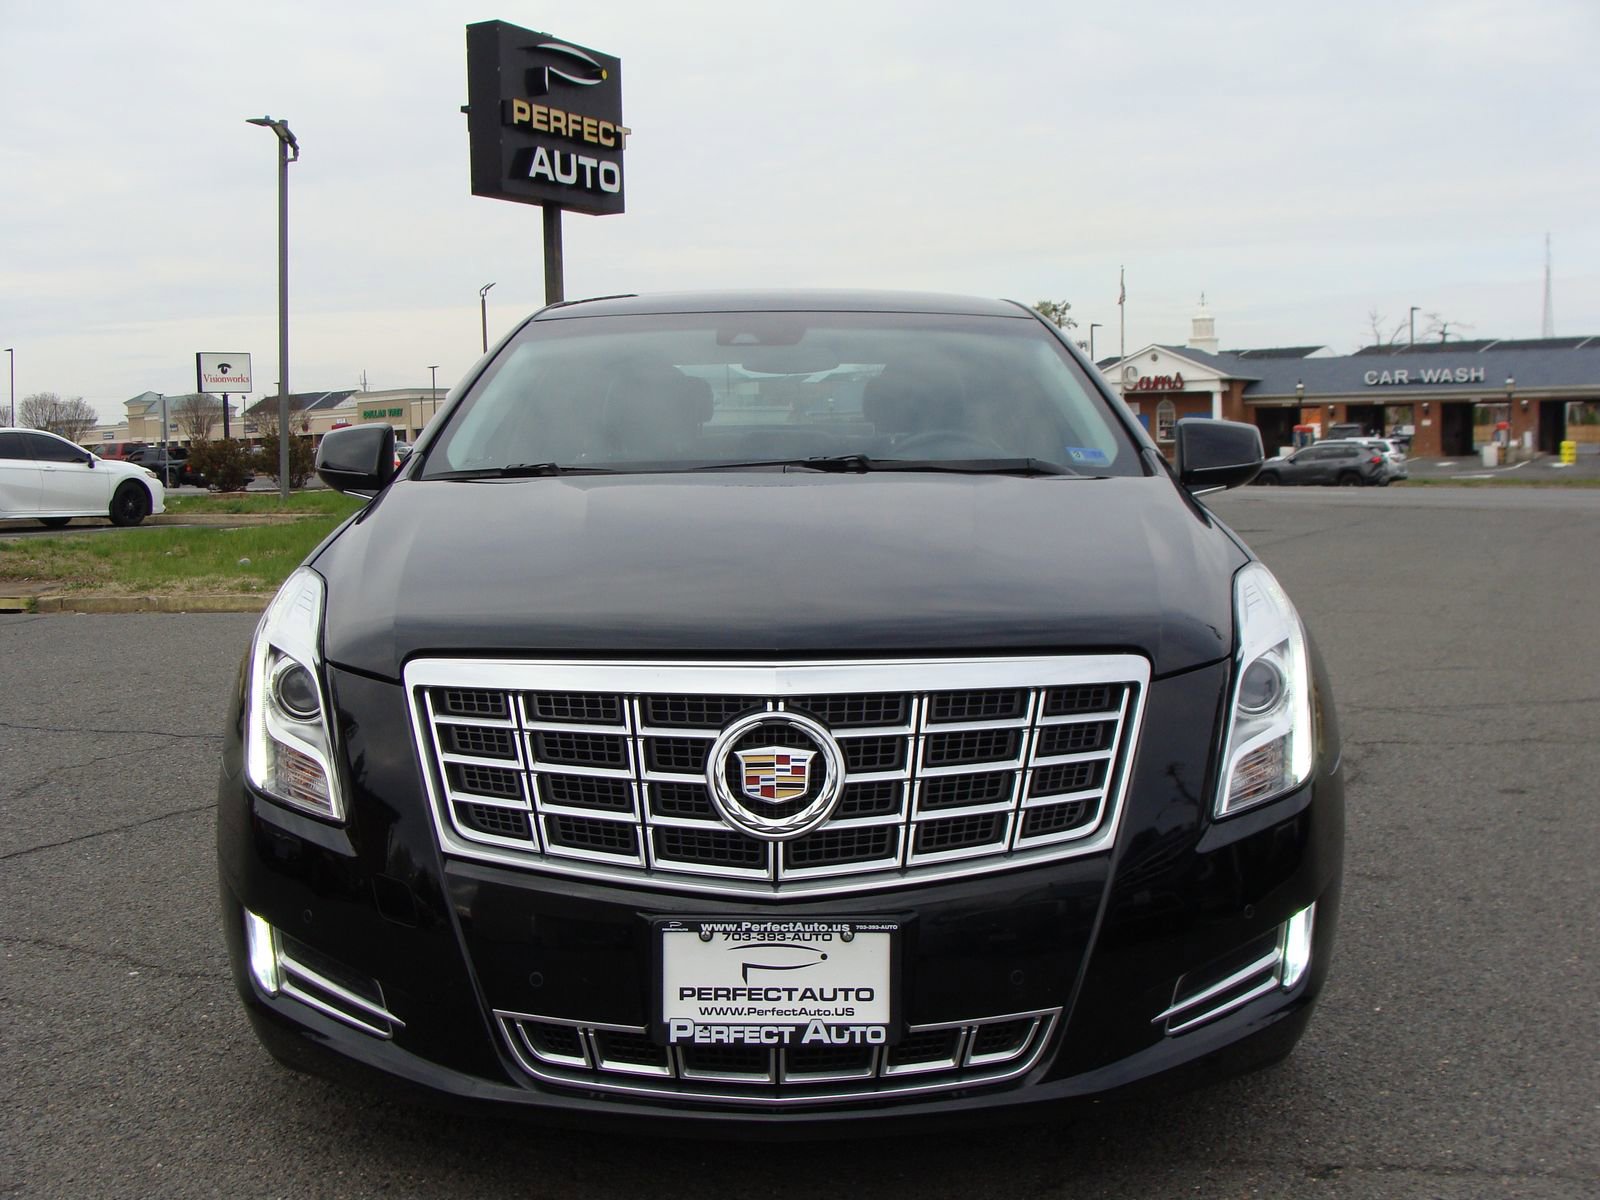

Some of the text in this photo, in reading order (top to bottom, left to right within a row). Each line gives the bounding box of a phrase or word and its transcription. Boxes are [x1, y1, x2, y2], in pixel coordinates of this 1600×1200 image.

[512, 98, 631, 150] PERFECT
[528, 145, 620, 193] AUTO
[204, 374, 250, 383] Visionworks
[1364, 367, 1485, 385] CAR WASH
[700, 922, 850, 932] www.PerfectAuto.us
[722, 932, 833, 942] 703-393-AUTO
[679, 987, 875, 1002] PERFECTAUTO
